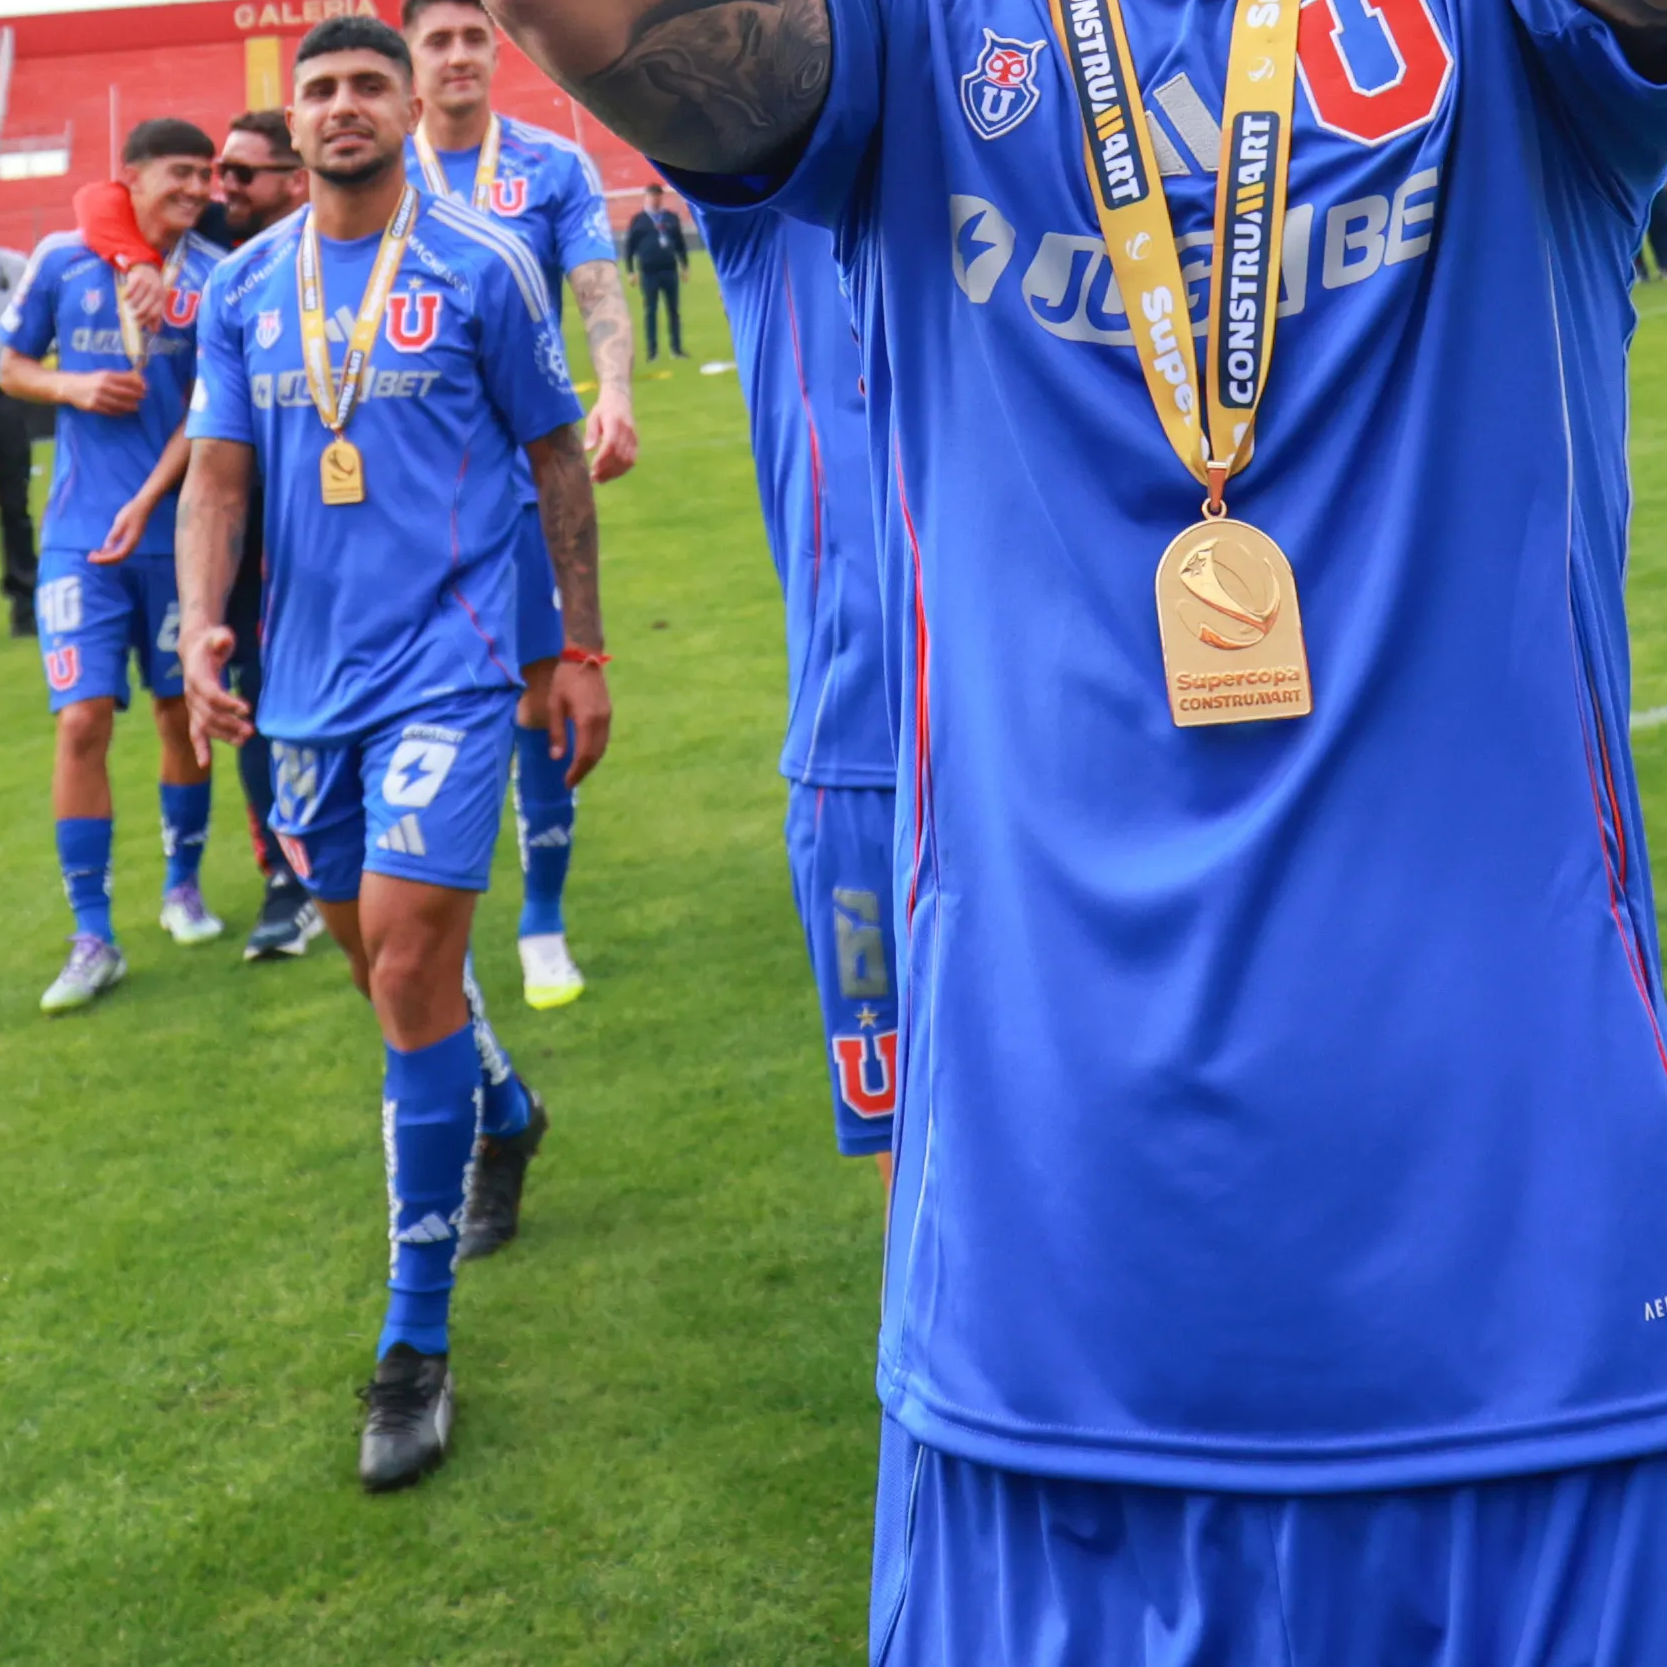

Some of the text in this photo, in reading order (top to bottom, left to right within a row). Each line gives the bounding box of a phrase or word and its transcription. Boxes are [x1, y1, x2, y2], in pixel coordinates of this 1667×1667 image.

[981, 86, 1015, 121] U
[386, 292, 442, 353] U
[1176, 667, 1301, 692] Supercopa
